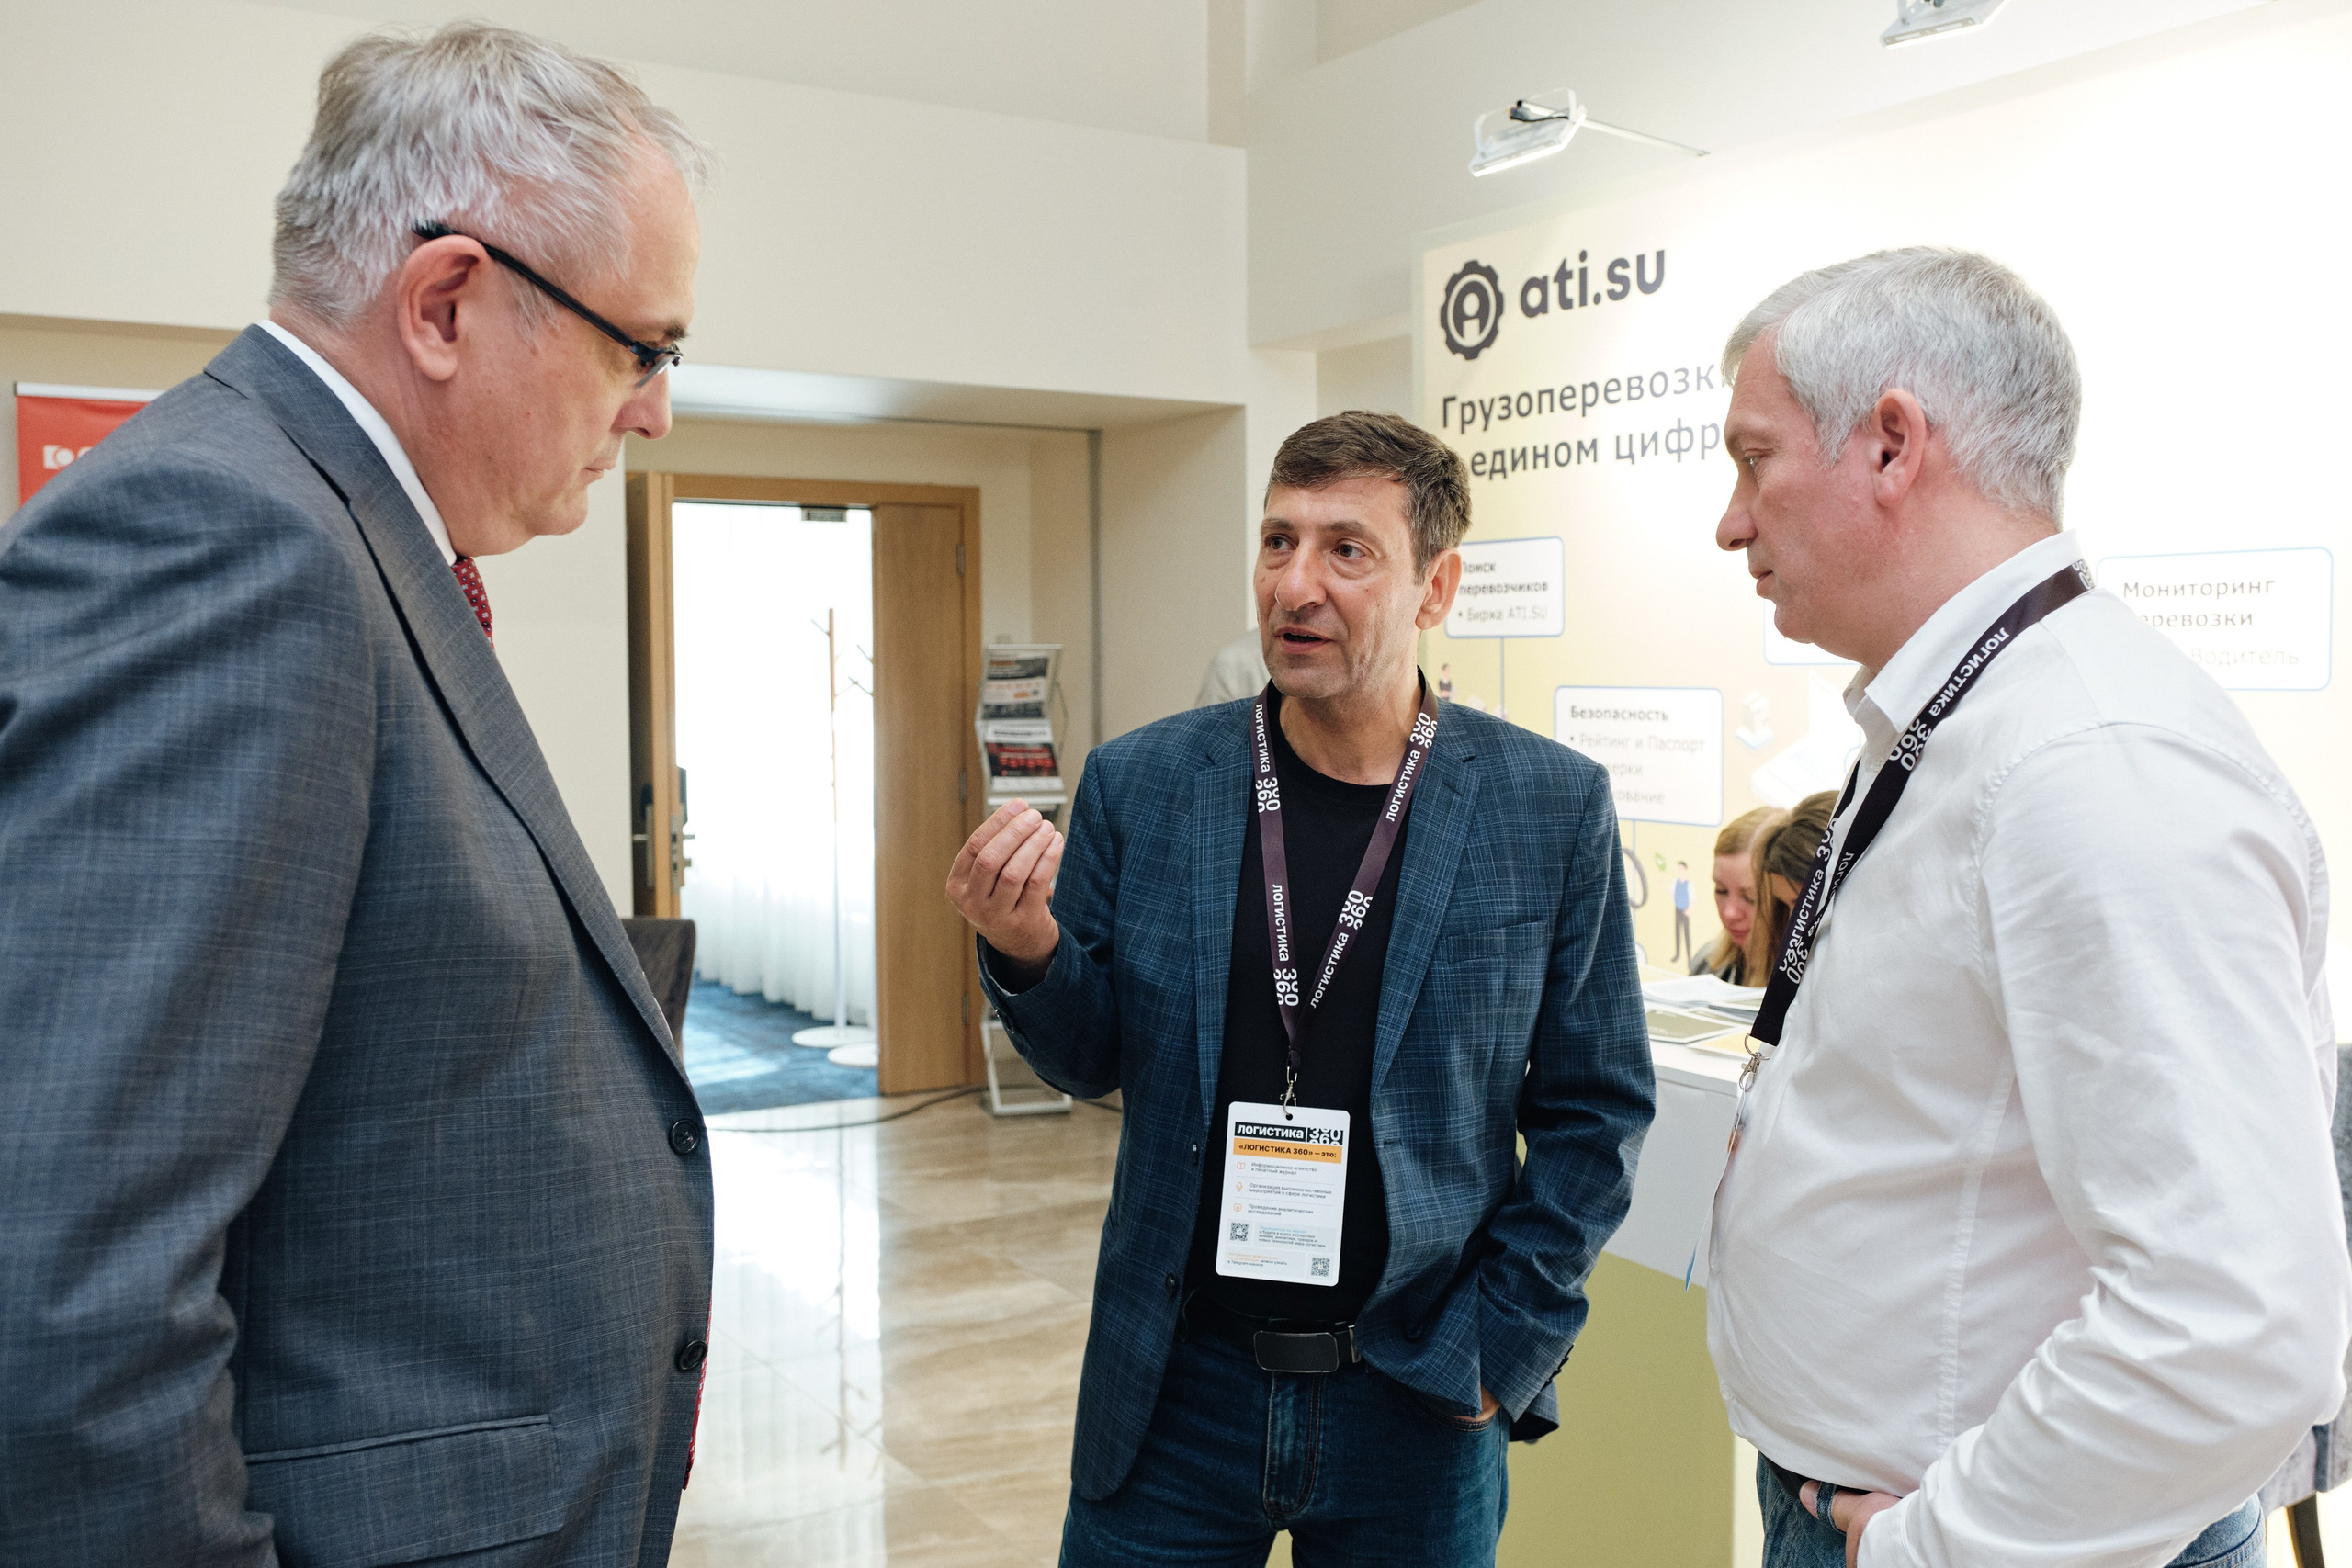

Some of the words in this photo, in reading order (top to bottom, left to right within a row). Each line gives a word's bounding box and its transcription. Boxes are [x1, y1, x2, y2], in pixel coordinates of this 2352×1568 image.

[1520, 249, 1665, 319] ati.su
[1442, 363, 1725, 434] Грузоперевозк
[1471, 438, 1598, 480] едином
[1616, 418, 1720, 464] цифр
[2123, 581, 2276, 600] Мониторинг
[1467, 607, 1503, 622] Биржа
[2140, 613, 2254, 627] ревозки
[1928, 626, 2010, 717] логистика
[2190, 648, 2300, 666] Водитель
[1571, 705, 1669, 721] Безопасность
[1255, 703, 1271, 773] логистика
[1581, 732, 1629, 749] Рейтинг
[1635, 739, 1644, 749] и
[1648, 735, 1705, 754] Паспорт
[1385, 750, 1421, 822] логистика
[1272, 884, 1289, 962] логистика
[1310, 931, 1350, 1009] логистика
[1237, 1124, 1305, 1139] логистика
[1238, 1144, 1292, 1155] «ЛОГИСТИКА
[1293, 1148, 1314, 1156] 360»
